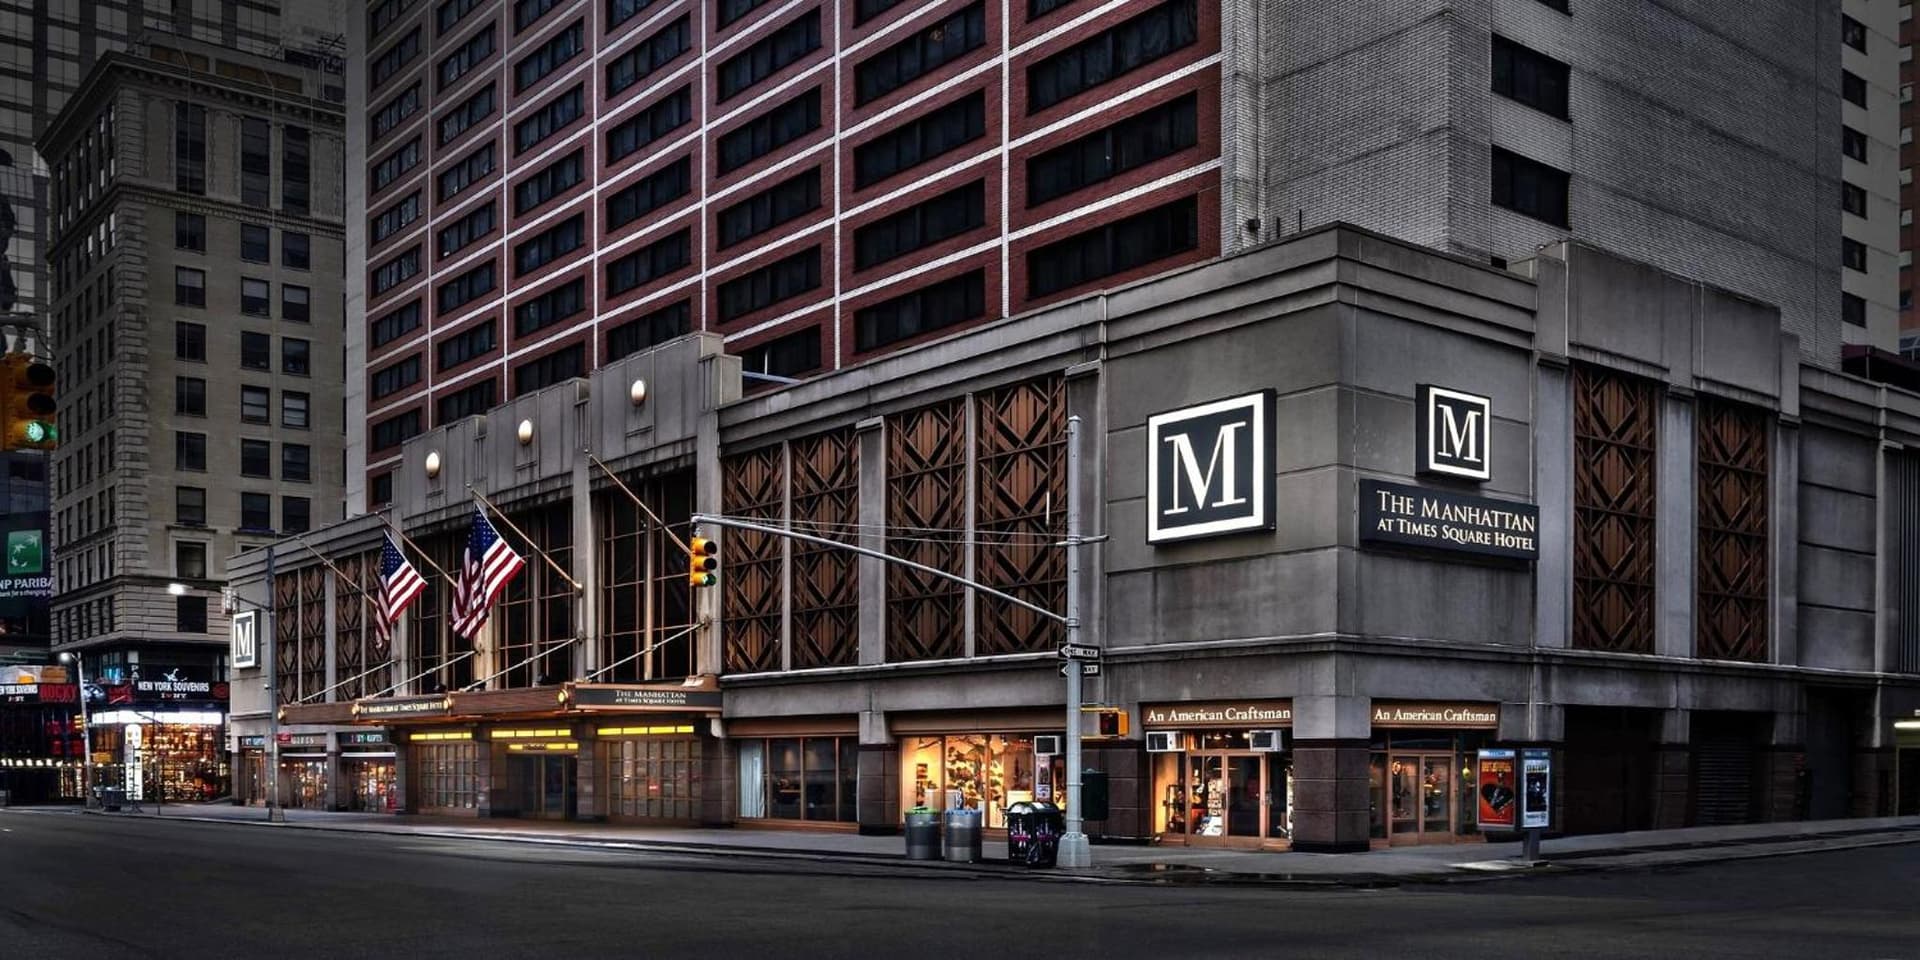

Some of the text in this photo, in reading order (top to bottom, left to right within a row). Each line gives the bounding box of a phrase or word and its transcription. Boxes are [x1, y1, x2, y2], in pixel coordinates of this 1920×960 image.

[1436, 404, 1482, 463] M
[1163, 421, 1247, 516] M
[1376, 490, 1535, 533] THE MANHATTAN
[1377, 517, 1536, 551] AT TIMES SQUARE HOTEL
[236, 621, 251, 658] M
[137, 681, 210, 692] NEW YORK SOUVENIRS
[634, 690, 687, 698] MANHATTAN
[1147, 706, 1291, 722] An American Craftsman
[1374, 708, 1497, 721] An American Craftsman
